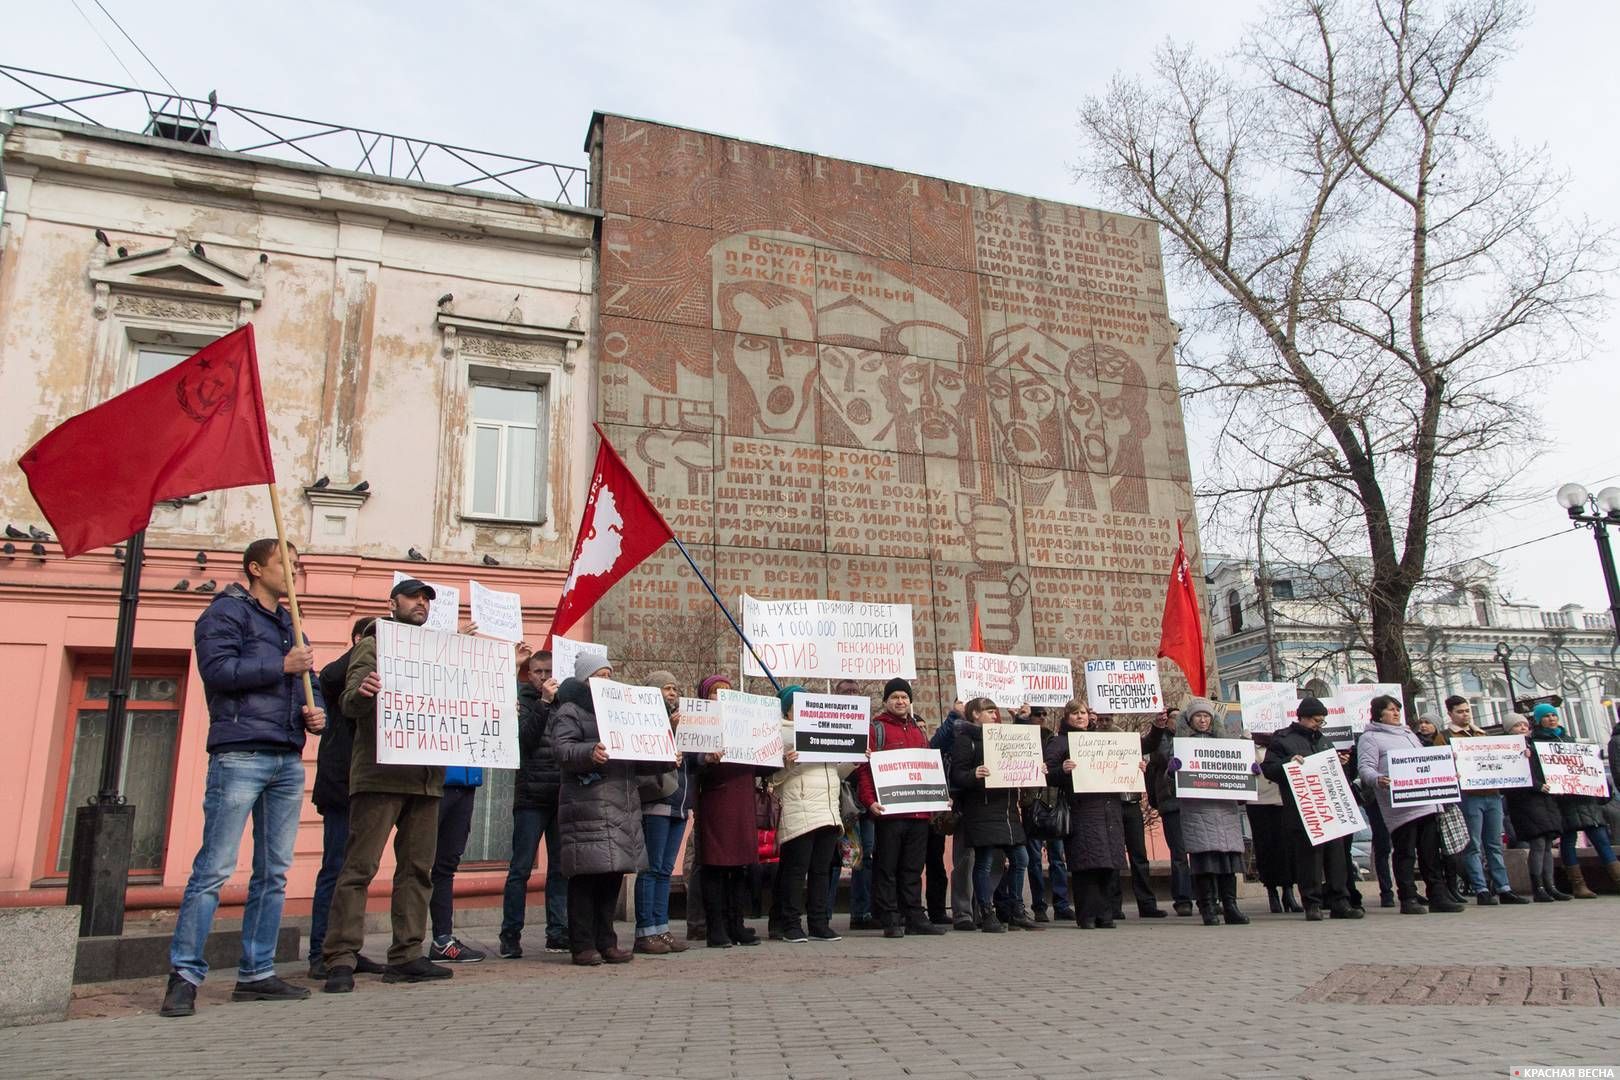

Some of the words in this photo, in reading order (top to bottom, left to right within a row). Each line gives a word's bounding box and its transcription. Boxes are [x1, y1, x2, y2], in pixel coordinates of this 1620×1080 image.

[974, 209, 1015, 227] ПОКА
[1019, 216, 1081, 237] ЖЕЛЕЗО
[1085, 230, 1139, 249] ГОРЯЧО
[1062, 238, 1100, 254] НАШ
[725, 250, 873, 283] ПРОКЛЯТЬЕМ
[977, 246, 1013, 262] НЫЙ
[1052, 261, 1061, 271] С
[1050, 248, 1060, 259] И
[1064, 250, 1143, 272] РЕШИТЕЛЬ
[978, 260, 1069, 285] ЦИОНАЛОМ
[725, 264, 915, 304] ЗАКЛЕЙМЕННЫЙ
[979, 273, 1010, 288] НЕТ
[1016, 279, 1045, 294] РОД
[1066, 300, 1148, 322] РАБОТНИКИ
[1062, 312, 1150, 335] ВСЕМИРНОЙ
[1037, 321, 1093, 339] АРМИИ
[1096, 329, 1146, 346] ТРУДА
[732, 442, 786, 457] ВЕСЬ
[791, 446, 835, 462] МИР
[839, 452, 897, 468] ГОЛОД-
[730, 457, 774, 471] НЫХ
[779, 461, 793, 473] И
[797, 463, 849, 478] РАБОВ
[727, 471, 764, 485] ПИТ
[769, 474, 812, 489] НАШ
[818, 479, 872, 495] РАЗУМ
[882, 484, 948, 501] ВОЗМУ-
[717, 487, 807, 503] ЩЕННЫЙ
[812, 493, 823, 505] И
[828, 494, 838, 506] В
[841, 495, 948, 516] СМЕРТНЫЙ
[676, 499, 738, 515] ВЕСТИ
[745, 503, 798, 519] ГОТОВ
[858, 513, 902, 526] МИР
[1023, 508, 1098, 523] ВЛАДЕТЬ
[1102, 514, 1171, 530] ЗЕМЛЕЙ
[719, 518, 831, 537] РАЗРУШИМ
[834, 526, 860, 539] ДО
[1024, 522, 1089, 537] ИМЕЕМ
[729, 534, 769, 548] МЫ
[832, 542, 870, 556] МЫ
[879, 544, 943, 561] НОВЫЙ
[847, 559, 888, 573] БЫЛ
[1055, 552, 1095, 566] ЕСЛИ
[1101, 556, 1145, 569] ГРОМ
[764, 570, 819, 584] ВСЕМ
[901, 578, 948, 592] ЕСТЬ
[1030, 567, 1084, 581] ЛИКИЙ
[1087, 571, 1143, 585] ГРЯНЕТ
[629, 579, 679, 593] НАШ
[828, 589, 841, 601] И
[1035, 582, 1105, 597] СВОРОЙ
[1111, 586, 1152, 599] ПСОВ
[629, 594, 679, 609] НЫЙ
[768, 602, 808, 616] НУЖЕН
[817, 602, 855, 616] ПРЯМОЙ
[859, 605, 893, 617] ОТВЕТ
[1112, 601, 1145, 613] ДЛЯ
[1034, 611, 1064, 624] ВСЕ
[1073, 613, 1104, 626] ТАК
[1110, 615, 1134, 627] ЖЕ
[752, 623, 770, 637] НА
[778, 622, 785, 636] 1
[790, 622, 813, 636] 000
[817, 621, 837, 637] 000
[842, 621, 898, 638] ПОДПИСЕЙ
[1064, 627, 1123, 641] СТАНЕТ
[748, 642, 819, 671] ПРОТИВ
[837, 641, 905, 657] ПЕНСИОННОЙ
[1037, 641, 1099, 656] ОГНЕМ
[841, 657, 901, 674] РЕФОРМЫ
[964, 655, 975, 669] НЕ
[978, 656, 1018, 674] БОРЕШЬСЯ
[1087, 661, 1116, 672] БУДЕМ
[384, 656, 471, 700] РЕФОРМА
[1108, 672, 1146, 684] ОТМЕНИМ
[623, 688, 637, 704] НЕ
[1097, 684, 1156, 697] ПЕНСИОННУЮ
[384, 691, 500, 719] ОБЯЗАННОСТЬ
[686, 700, 711, 713] НЕТ
[805, 700, 824, 709] Народ
[824, 702, 850, 711] негодует
[384, 710, 469, 735] РАБОТАТЬ
[481, 720, 500, 736] ДО
[607, 710, 665, 728] РАБОТАТЬ
[800, 710, 839, 719] ЛЮДОЕДСКУЮ
[839, 712, 866, 721] РЕФОРМУ
[818, 720, 830, 729] СМИ
[609, 731, 625, 751] ДО
[810, 736, 820, 745] Это
[1194, 748, 1242, 759] ГОЛОСОВАЛ
[878, 760, 940, 773] КОНСТИТУЦИОННЫЙ
[1189, 760, 1200, 770] ЗА
[1201, 761, 1248, 772] ПЕНСИОНКУ
[908, 771, 923, 782] СУД
[1198, 772, 1249, 781] проголосовал
[892, 789, 916, 797] отмени
[916, 787, 946, 797] пенсионку!
[1306, 774, 1335, 823] БОРЬБА
[1288, 765, 1325, 839] НЕОБХОДИМА
